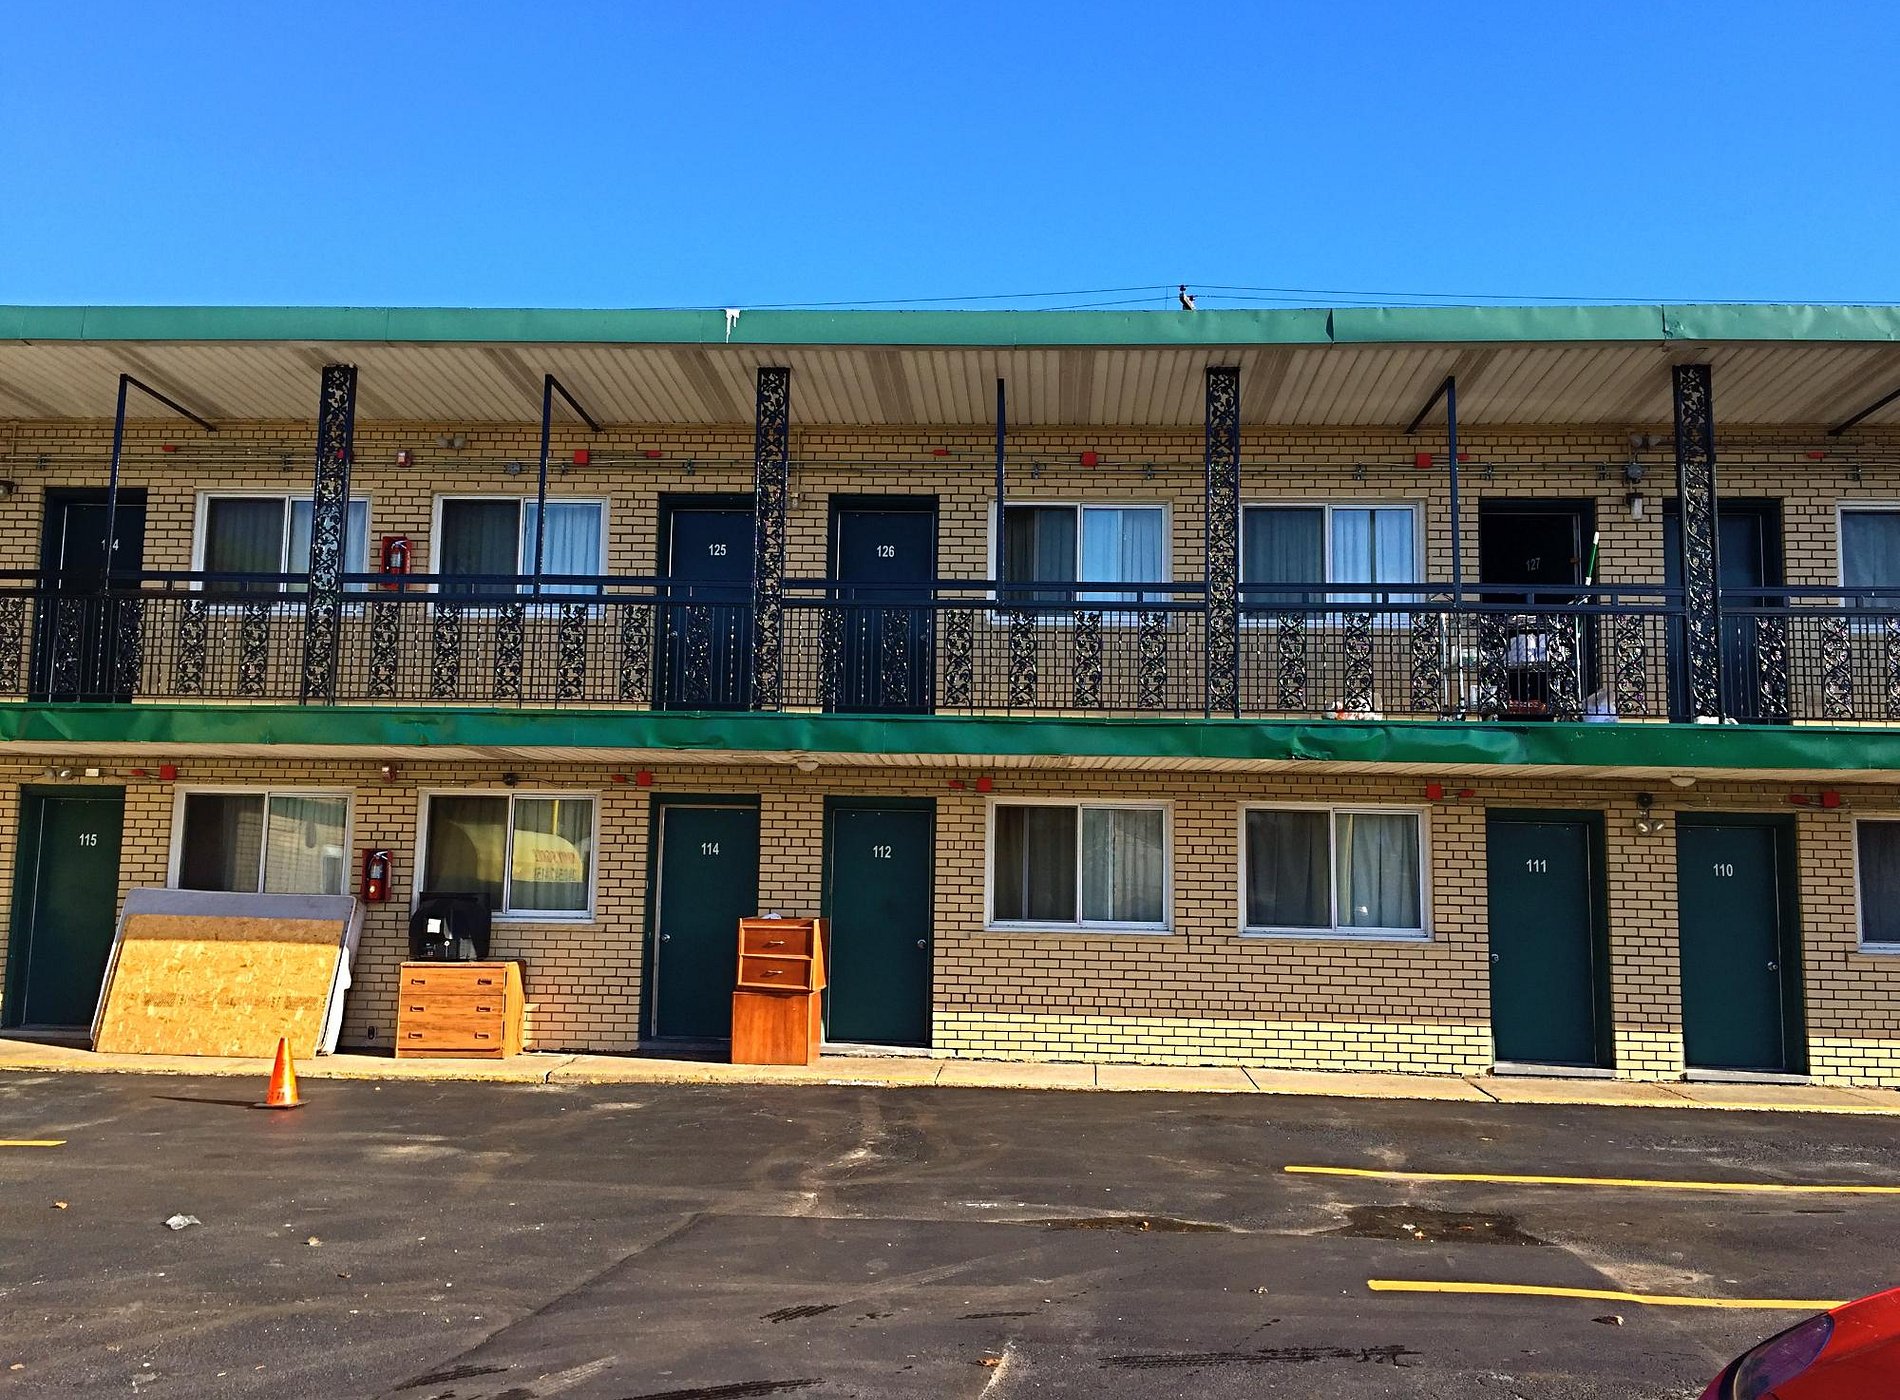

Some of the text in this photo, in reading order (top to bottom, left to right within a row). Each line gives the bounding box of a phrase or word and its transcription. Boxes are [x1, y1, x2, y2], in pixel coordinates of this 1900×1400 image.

[101, 539, 119, 551] 14
[708, 543, 727, 556] 125
[876, 545, 895, 558] 126
[1525, 557, 1541, 571] 127
[79, 833, 98, 847] 115
[701, 842, 720, 856] 114
[872, 845, 892, 859] 112
[1526, 859, 1547, 873] 111
[1713, 863, 1734, 877] 110
